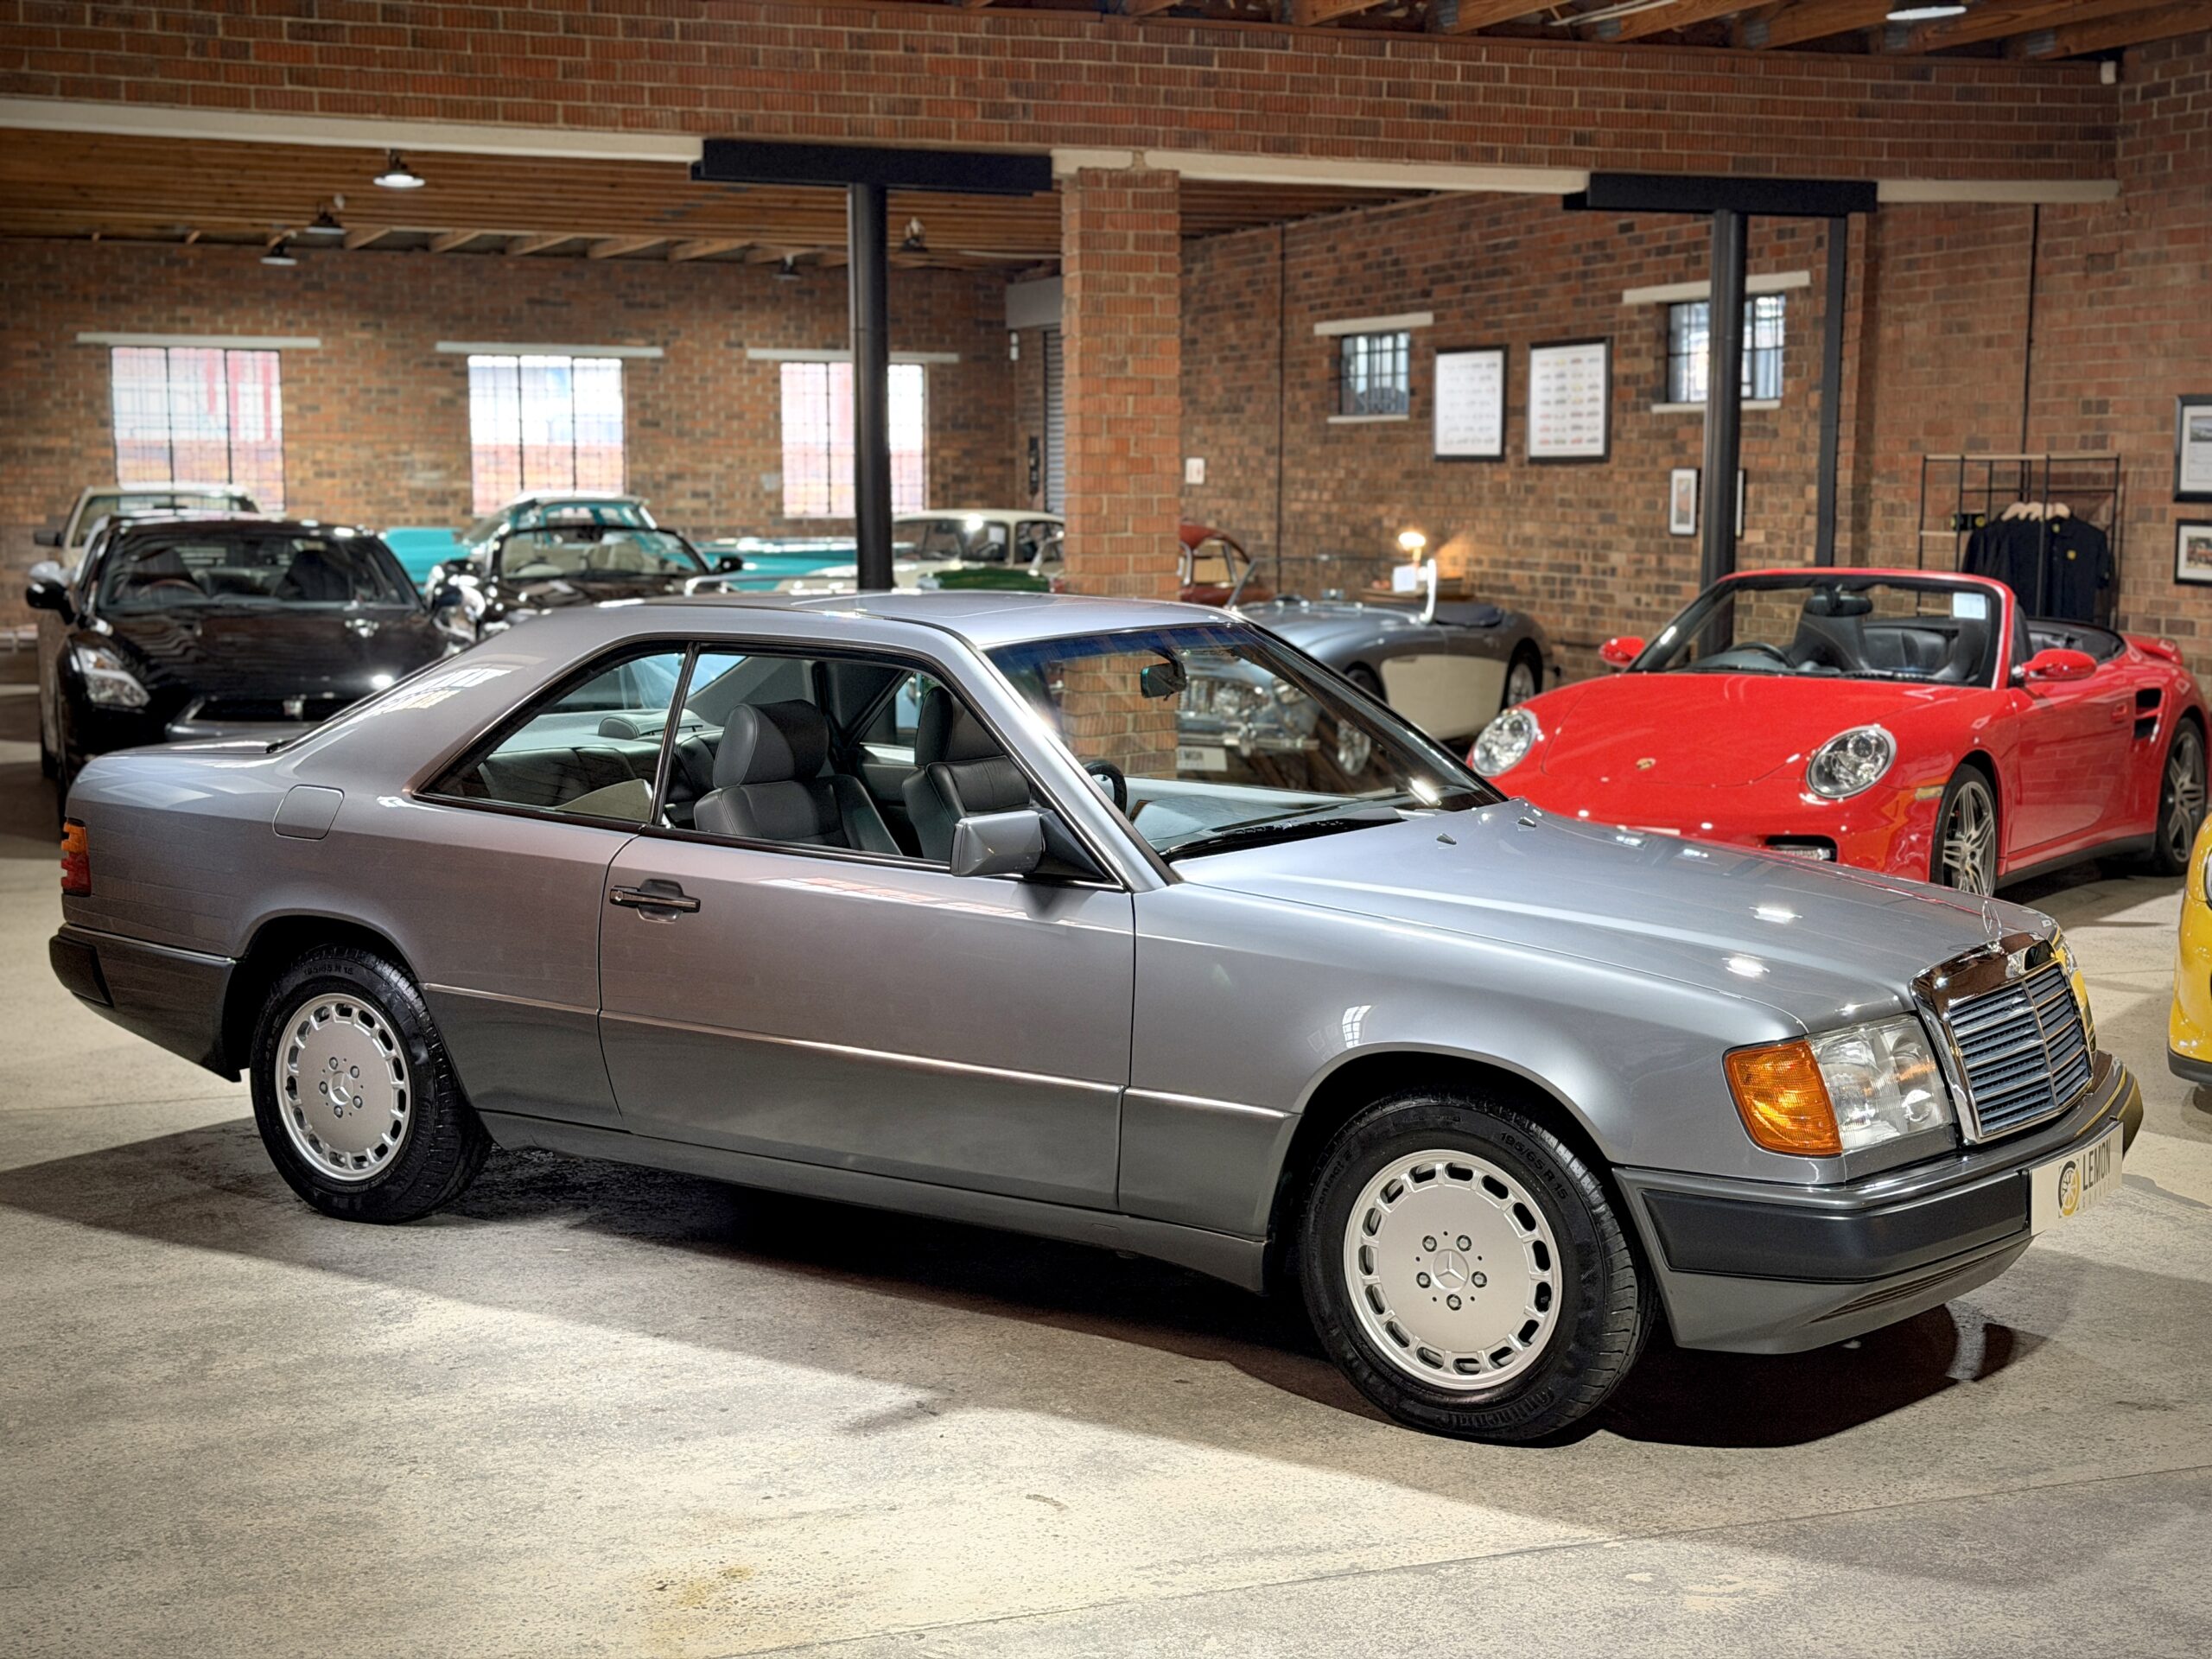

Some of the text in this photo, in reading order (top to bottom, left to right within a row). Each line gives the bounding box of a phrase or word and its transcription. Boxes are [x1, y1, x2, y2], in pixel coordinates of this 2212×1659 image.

[1500, 1132, 1568, 1199] 195/65 R 15
[2083, 1136, 2111, 1191] LEMON
